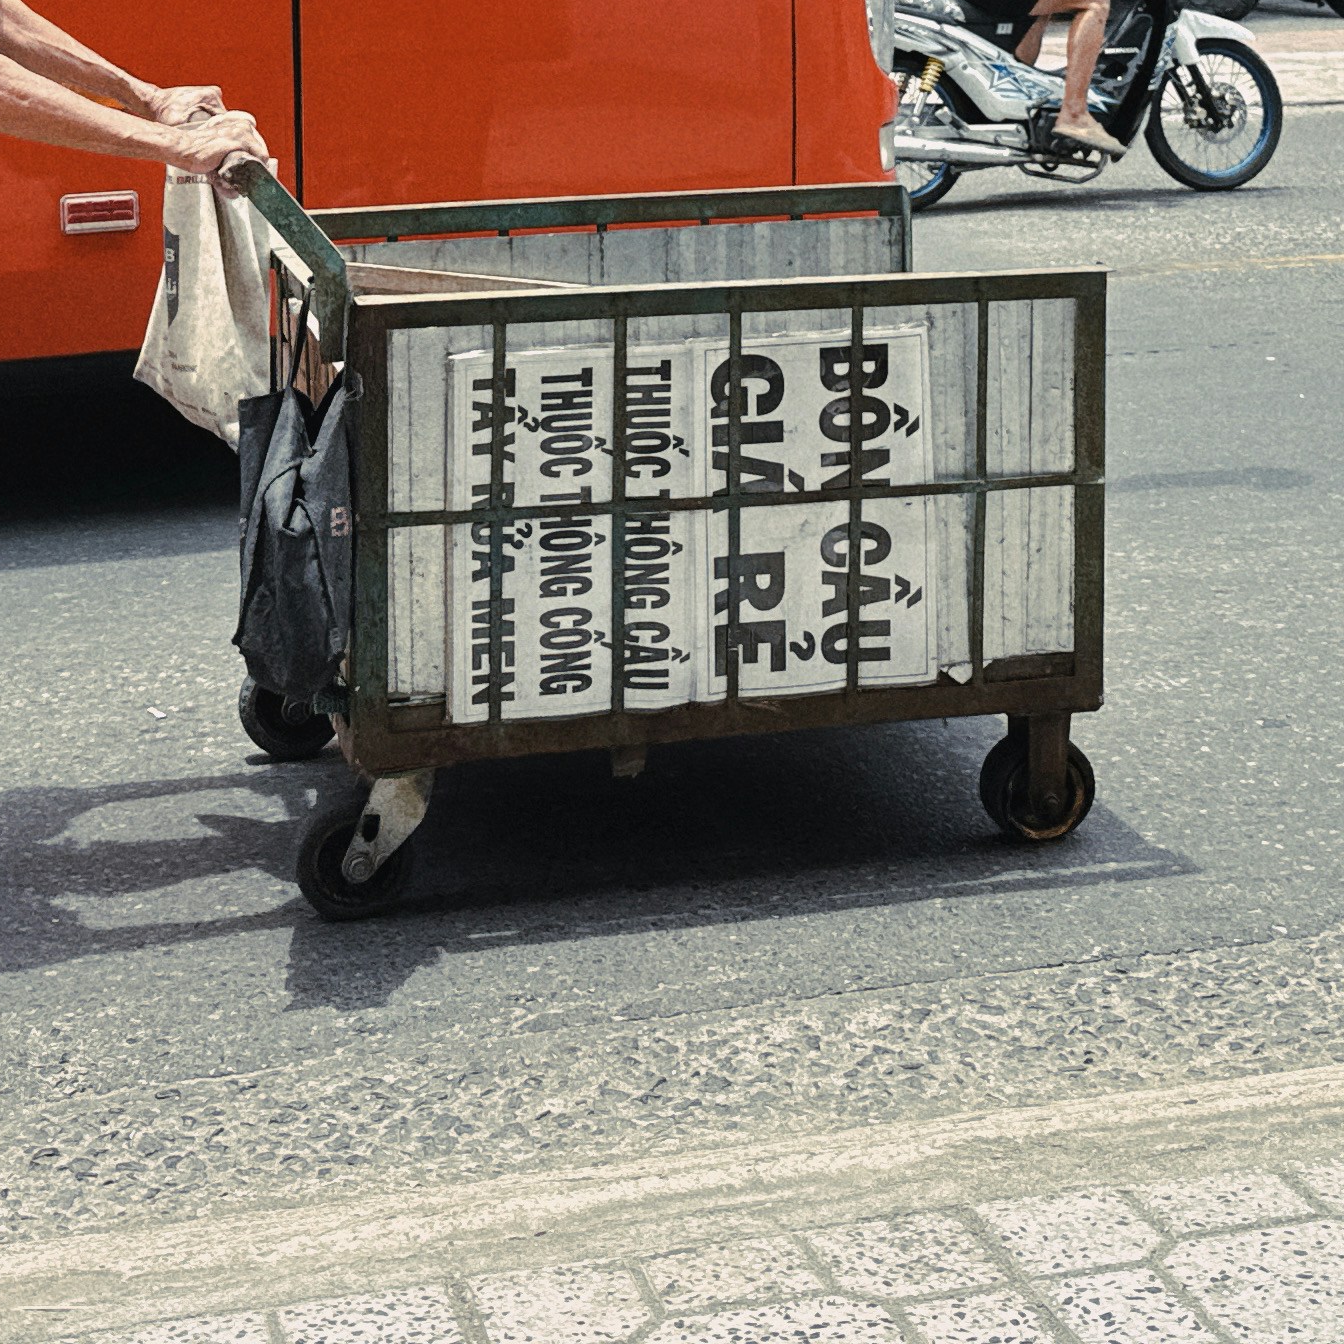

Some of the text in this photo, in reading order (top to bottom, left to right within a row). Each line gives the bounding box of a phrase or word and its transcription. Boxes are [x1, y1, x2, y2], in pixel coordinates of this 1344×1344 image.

[472, 368, 541, 463] TẨY
[539, 367, 614, 696] THUỐC THÔNG CỐNG
[622, 360, 690, 689] THUỐC THÔNG CẦU
[710, 353, 815, 678] GIÁ RẺ
[818, 343, 923, 666] BỒN CẦU
[472, 599, 516, 704] MEN
